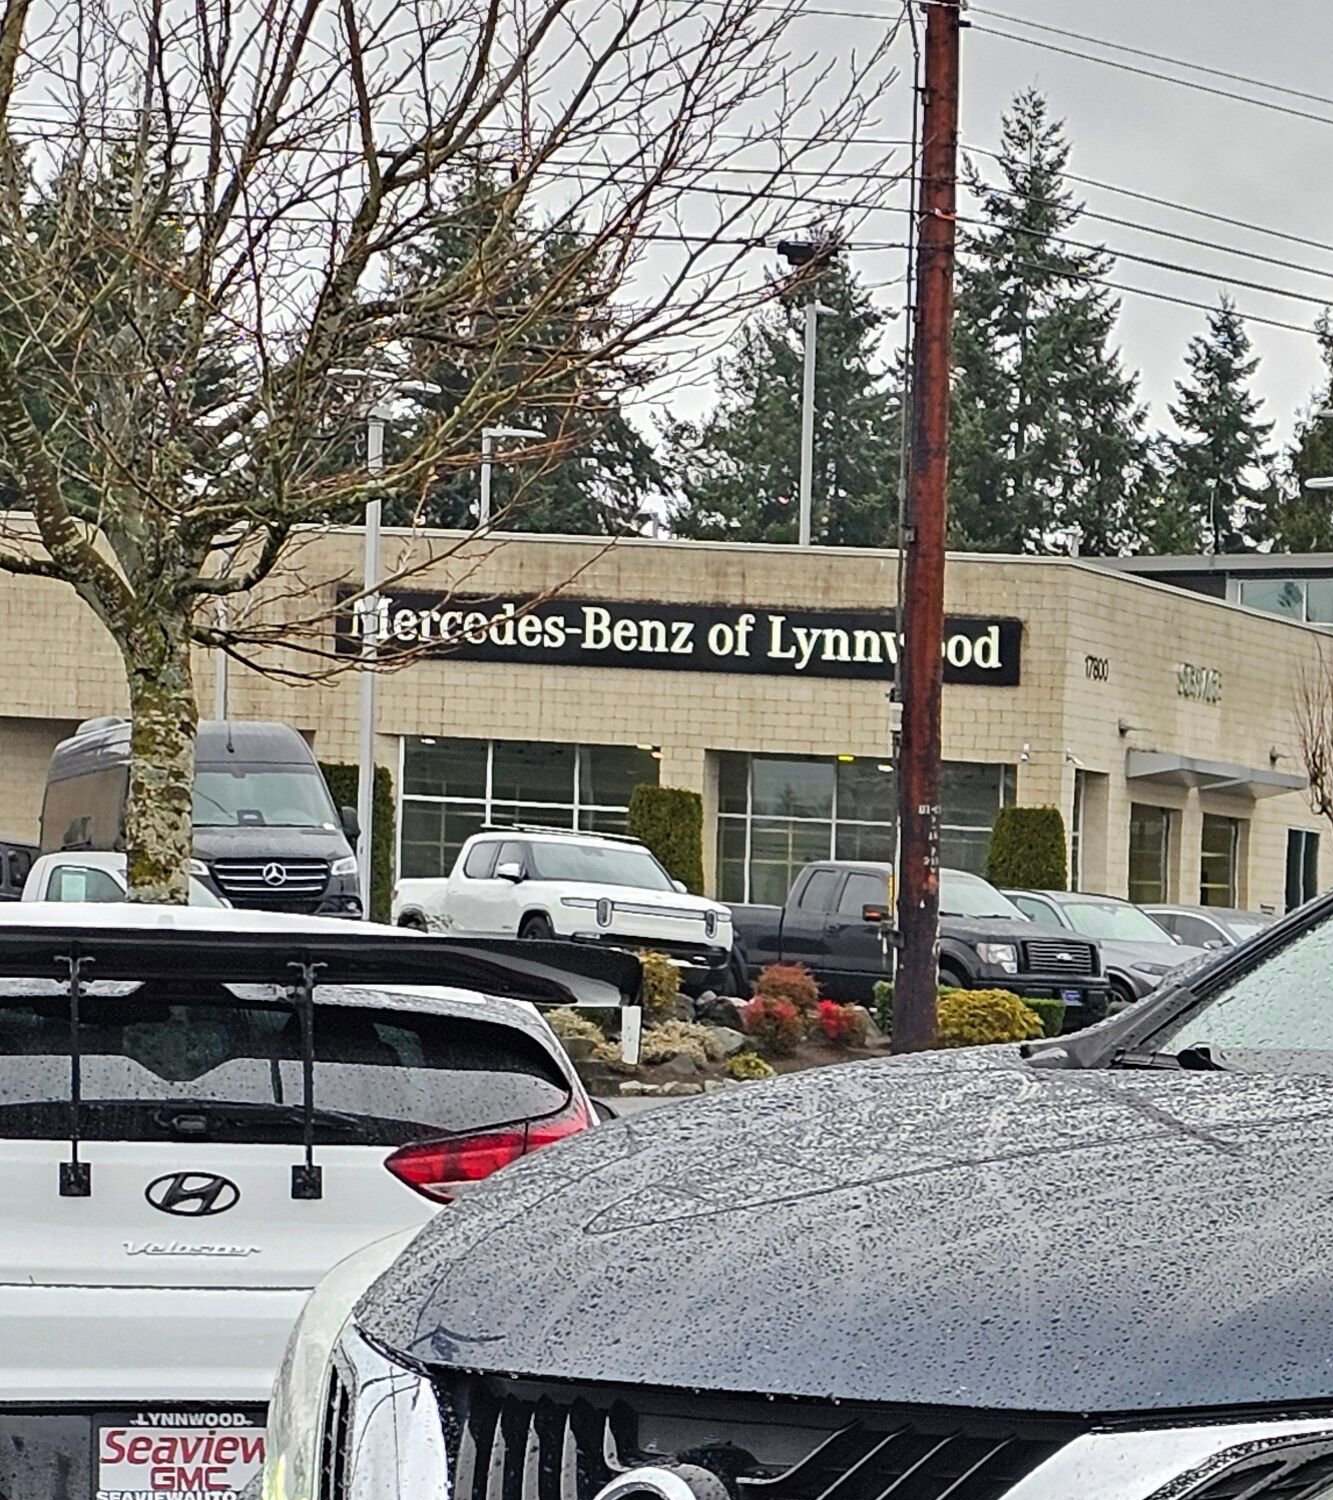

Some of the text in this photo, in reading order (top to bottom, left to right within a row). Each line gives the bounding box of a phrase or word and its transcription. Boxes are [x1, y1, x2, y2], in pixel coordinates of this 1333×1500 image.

[707, 613, 756, 657] of
[766, 614, 1002, 670] Lynnod
[1084, 655, 1109, 682] 17800
[136, 1412, 246, 1427] LYNNWOOD
[150, 1466, 233, 1491] GMC
